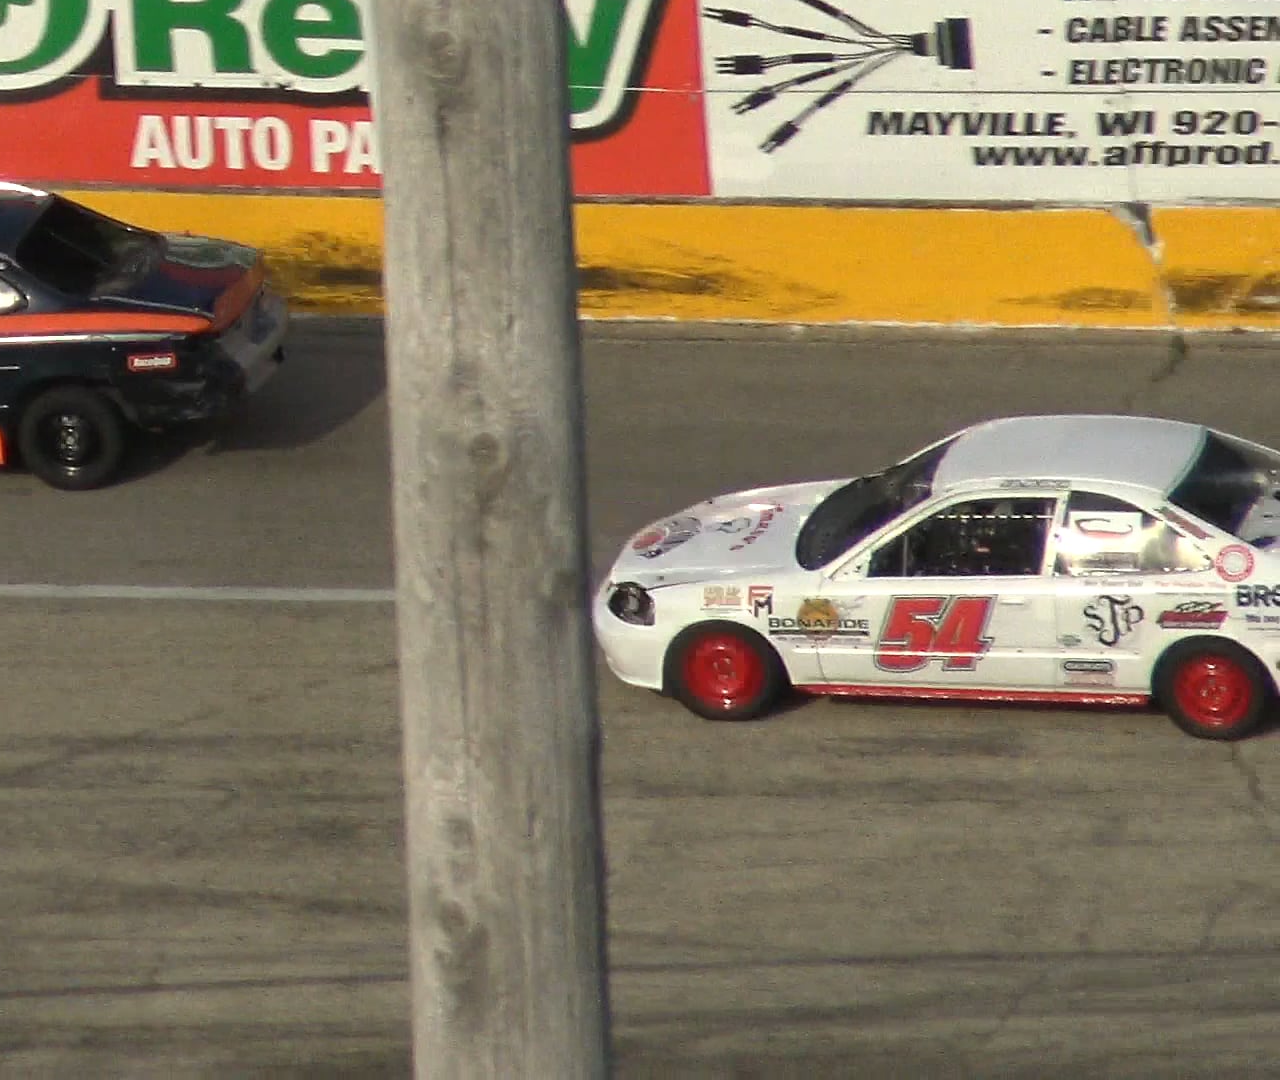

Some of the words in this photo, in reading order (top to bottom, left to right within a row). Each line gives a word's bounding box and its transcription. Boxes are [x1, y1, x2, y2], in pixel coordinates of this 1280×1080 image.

[1065, 16, 1169, 43] CABLE
[1068, 57, 1268, 85] ELECTRONIC
[867, 110, 1078, 139] MAYVILLE,
[1095, 110, 1156, 136] WI
[129, 114, 293, 171] AUTO
[872, 593, 1000, 674] 54
